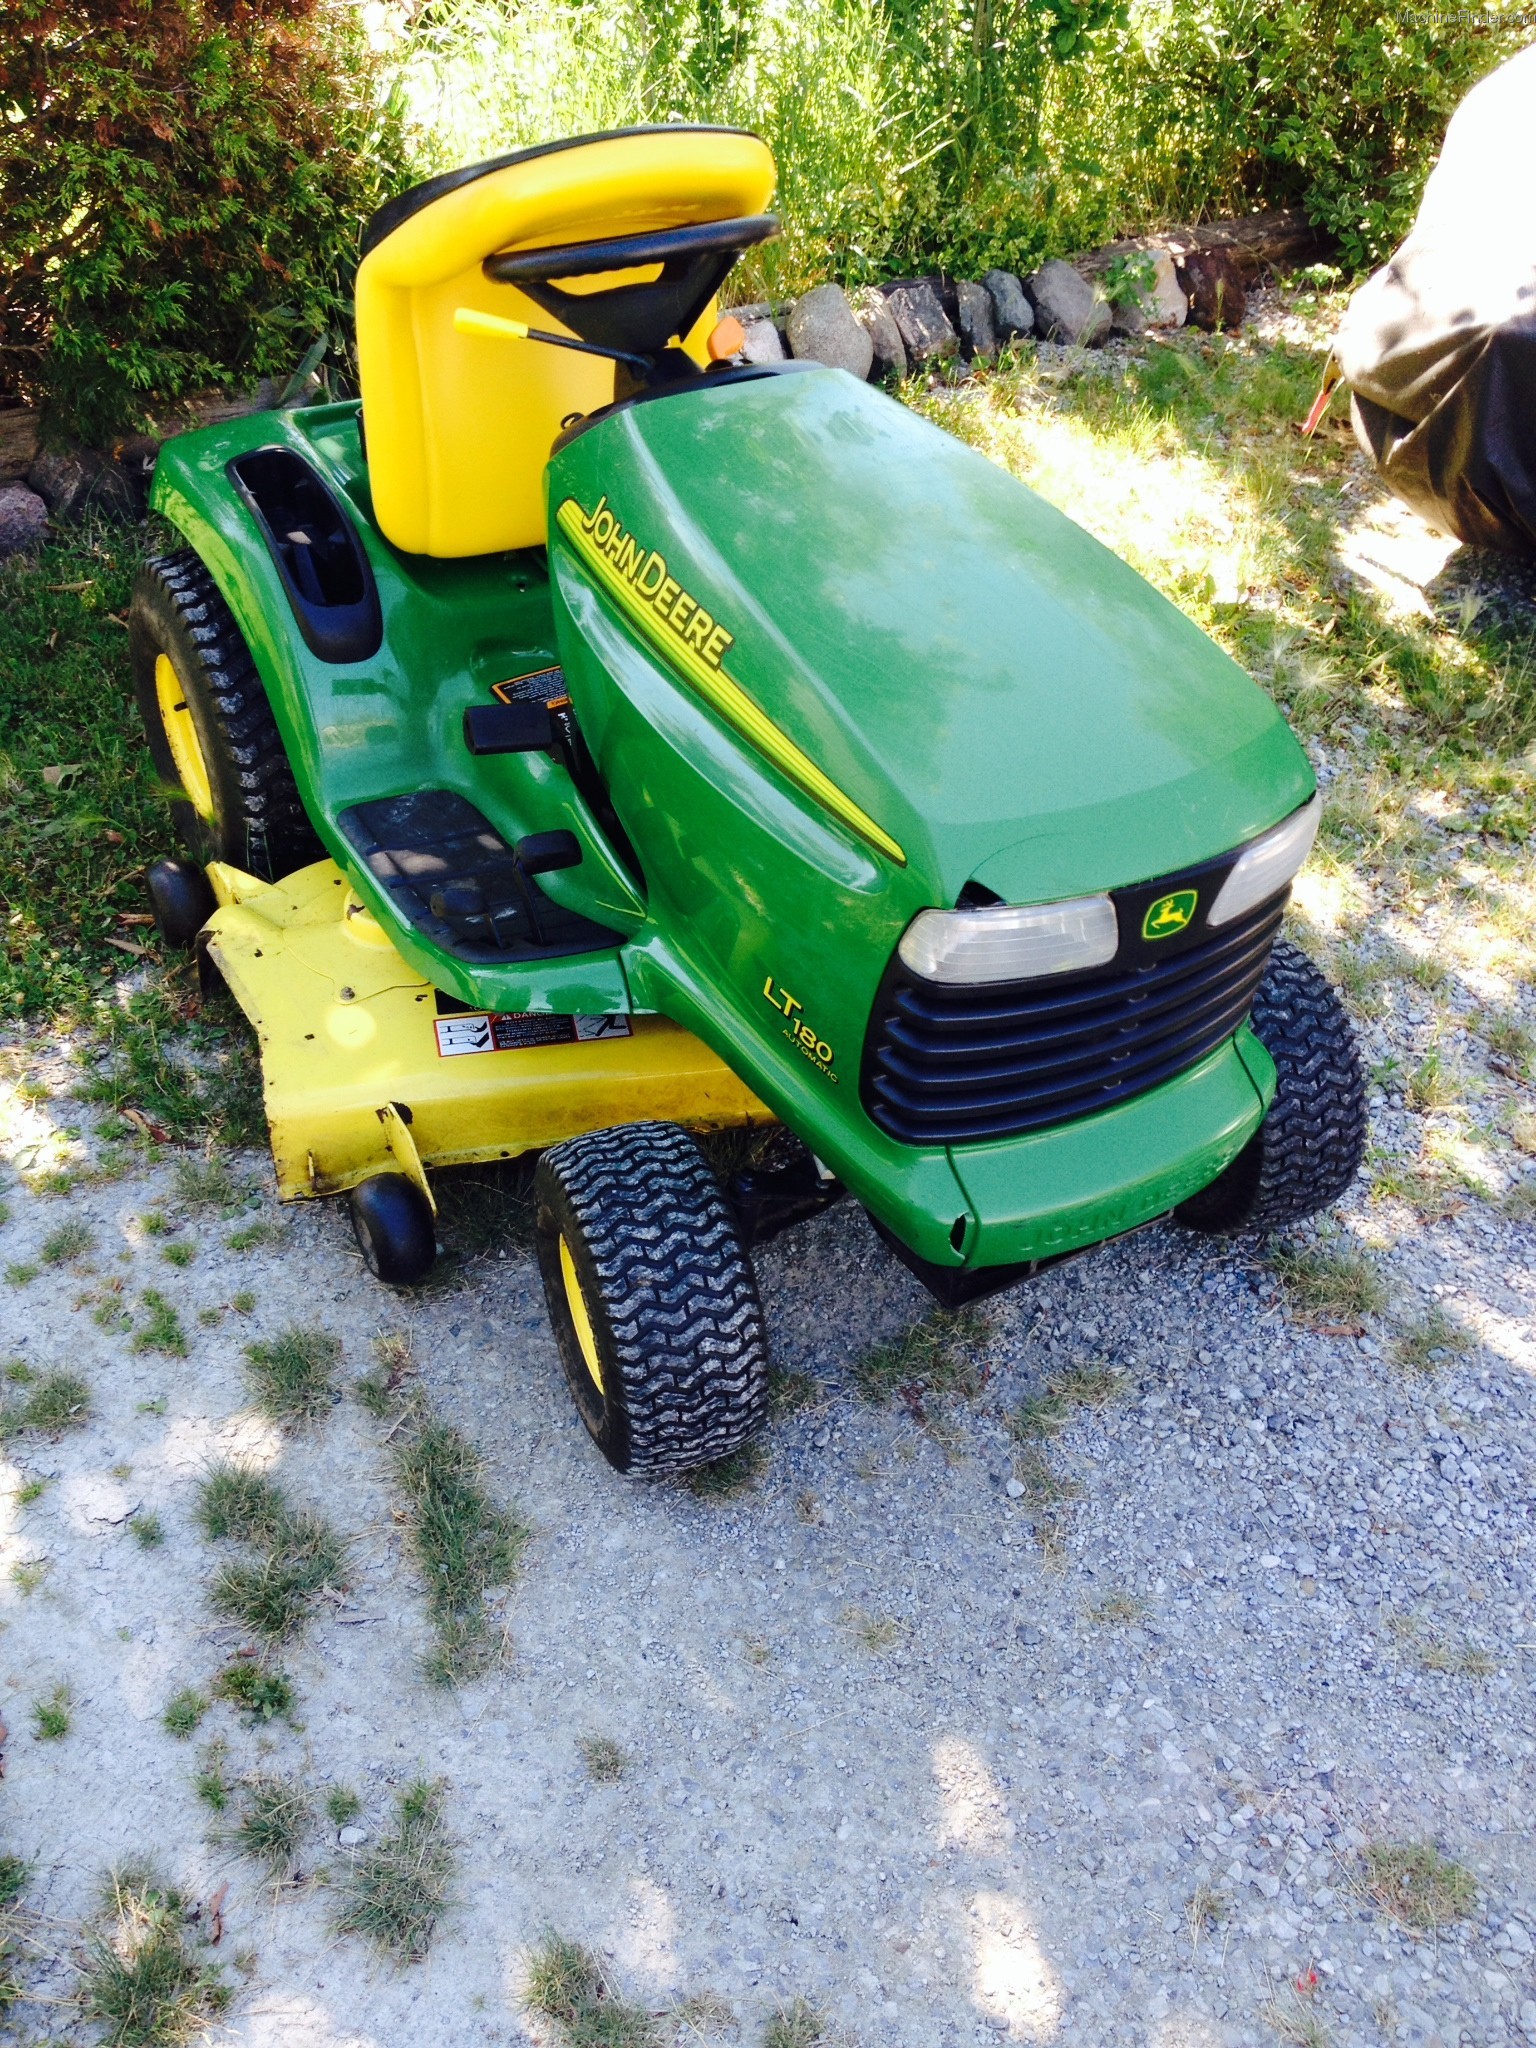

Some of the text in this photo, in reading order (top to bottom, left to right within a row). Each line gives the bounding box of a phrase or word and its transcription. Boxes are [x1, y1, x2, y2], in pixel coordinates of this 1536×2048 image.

[581, 495, 735, 671] JOHN DEERE
[763, 976, 834, 1063] LT 180
[781, 1028, 839, 1084] AUTOMATIC
